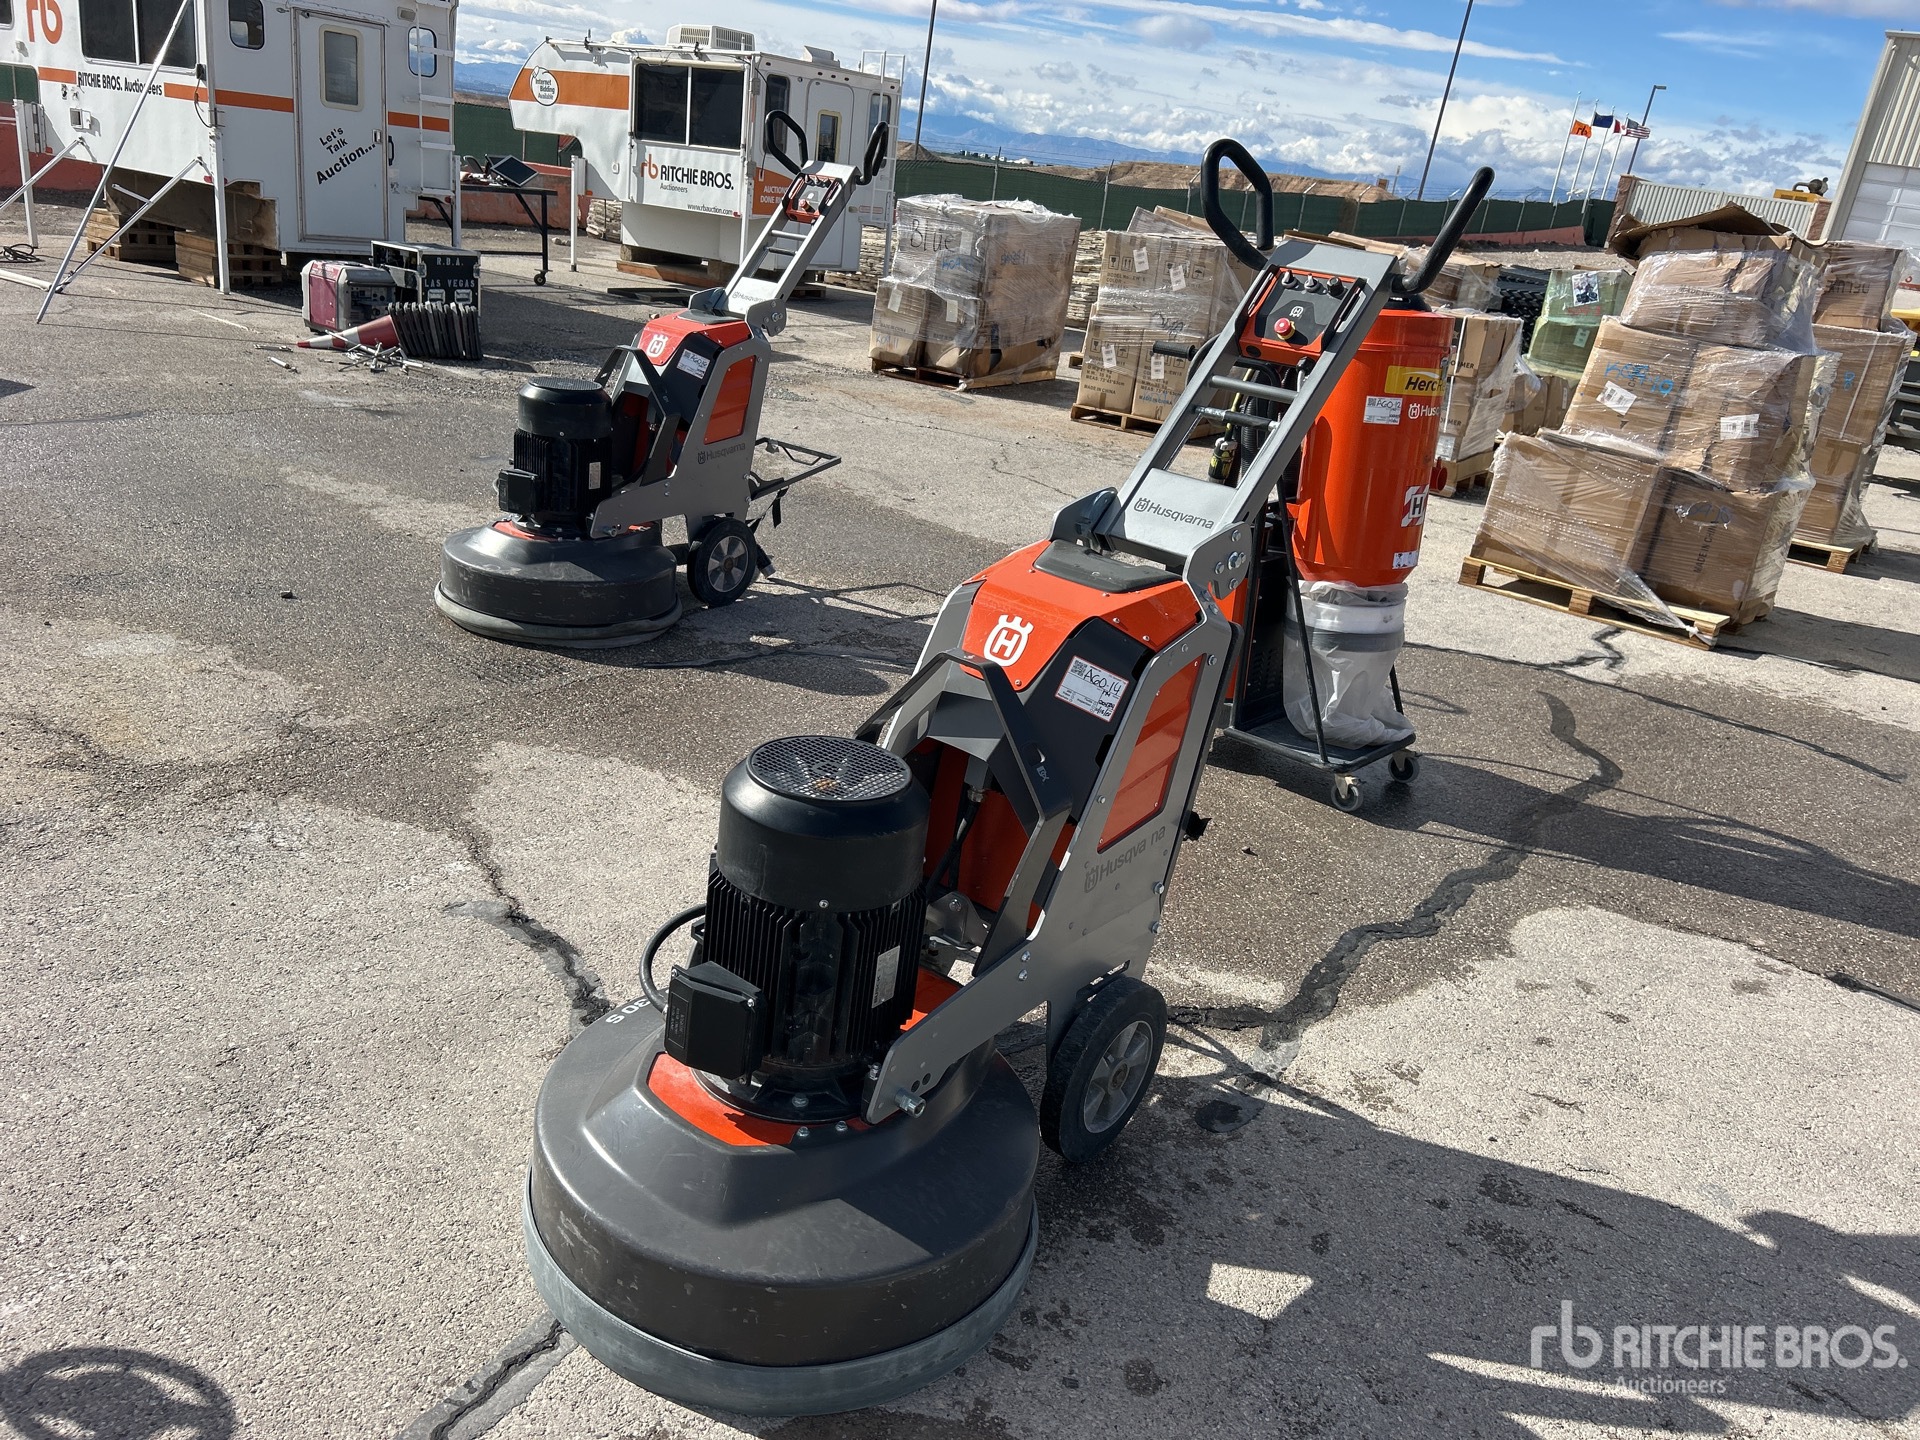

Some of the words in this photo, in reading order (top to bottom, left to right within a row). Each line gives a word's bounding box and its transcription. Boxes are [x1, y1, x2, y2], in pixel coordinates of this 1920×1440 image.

[78, 71, 101, 88] RITCHIE
[102, 74, 122, 91] BROS.
[124, 76, 162, 96] Auctioeers
[319, 127, 344, 146] Let's
[326, 138, 348, 154] Talk
[316, 143, 376, 185] Auction...
[660, 164, 698, 185] RITCHIE
[700, 169, 734, 191] BROS.
[659, 182, 688, 193] Auctioneers
[760, 195, 775, 203] DONE
[687, 203, 733, 215] www.rbauction.com
[910, 218, 955, 252] Blue
[436, 257, 464, 266] R.B.A.
[424, 279, 441, 288] LAS
[447, 279, 475, 288] VEGAS
[706, 443, 746, 460] Husqvarna
[1147, 502, 1215, 529] Husqvarna
[1693, 552, 1707, 573] MADE
[1701, 544, 1711, 552] IN
[1100, 825, 1166, 881] Husqvana
